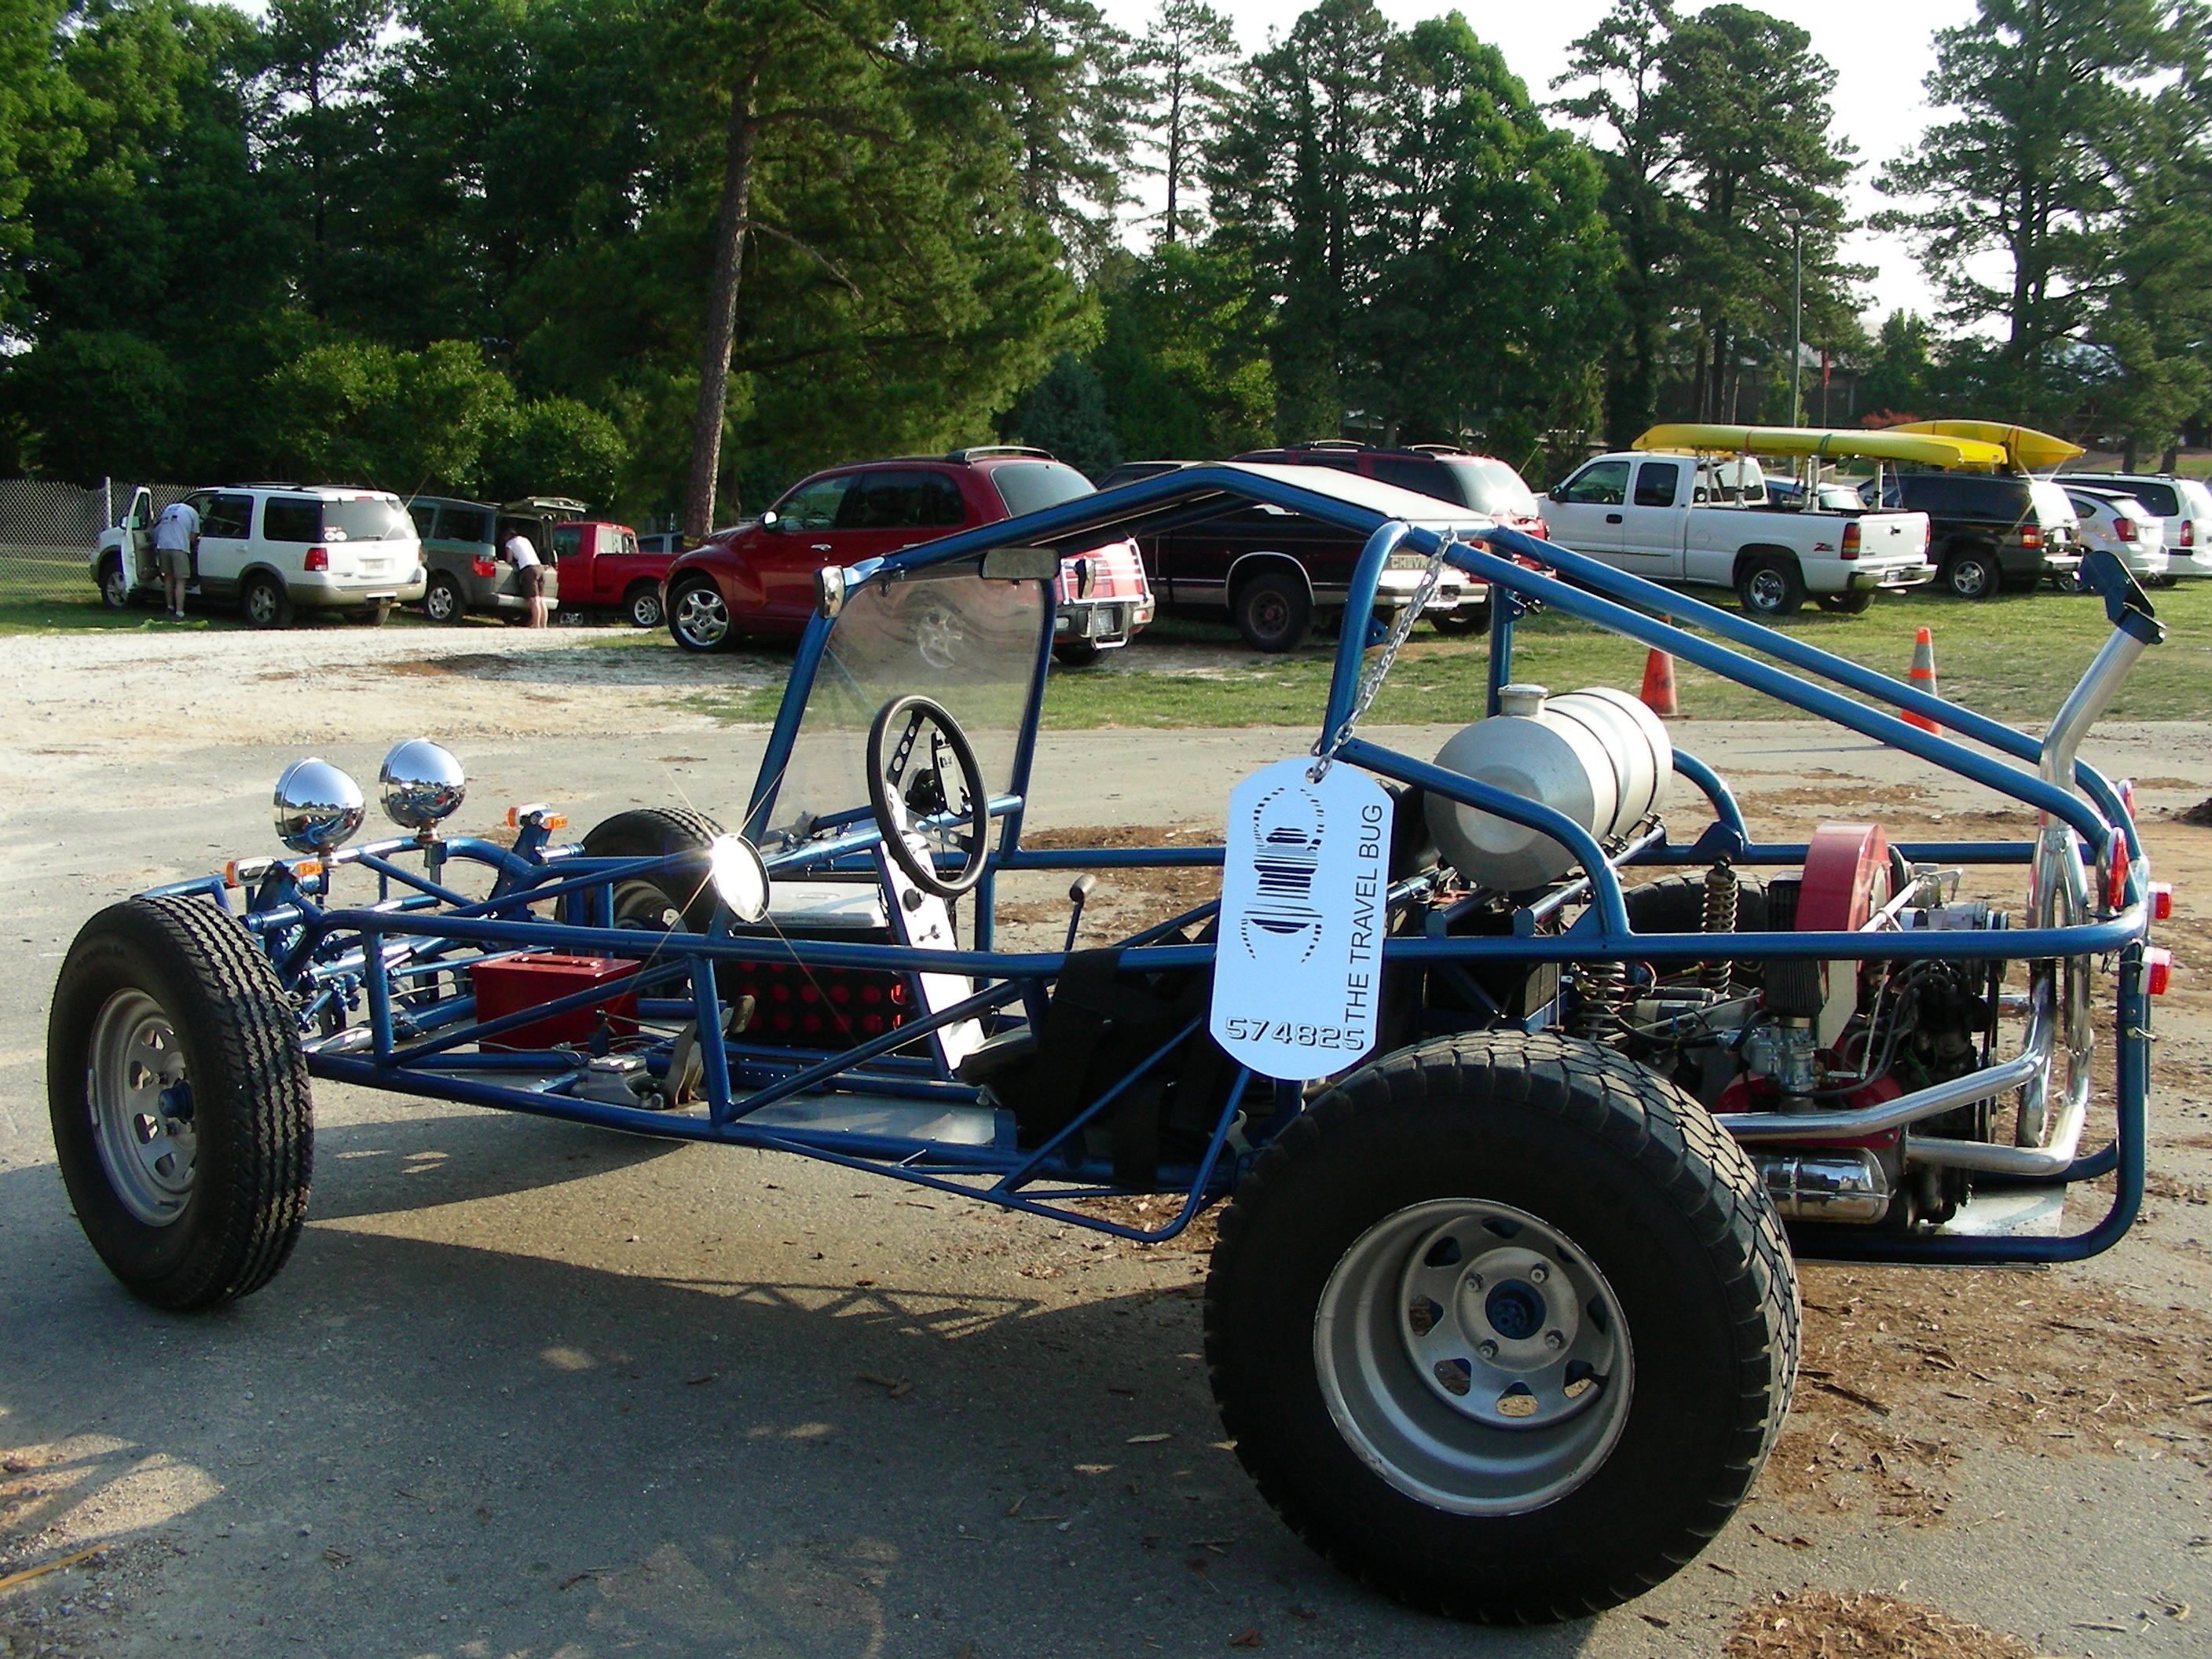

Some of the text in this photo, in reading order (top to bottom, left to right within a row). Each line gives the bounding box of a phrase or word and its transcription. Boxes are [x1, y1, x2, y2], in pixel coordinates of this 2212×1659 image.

[1345, 804, 1383, 1024] THE TRAVEL BUG
[1225, 1016, 1365, 1051] 574825
